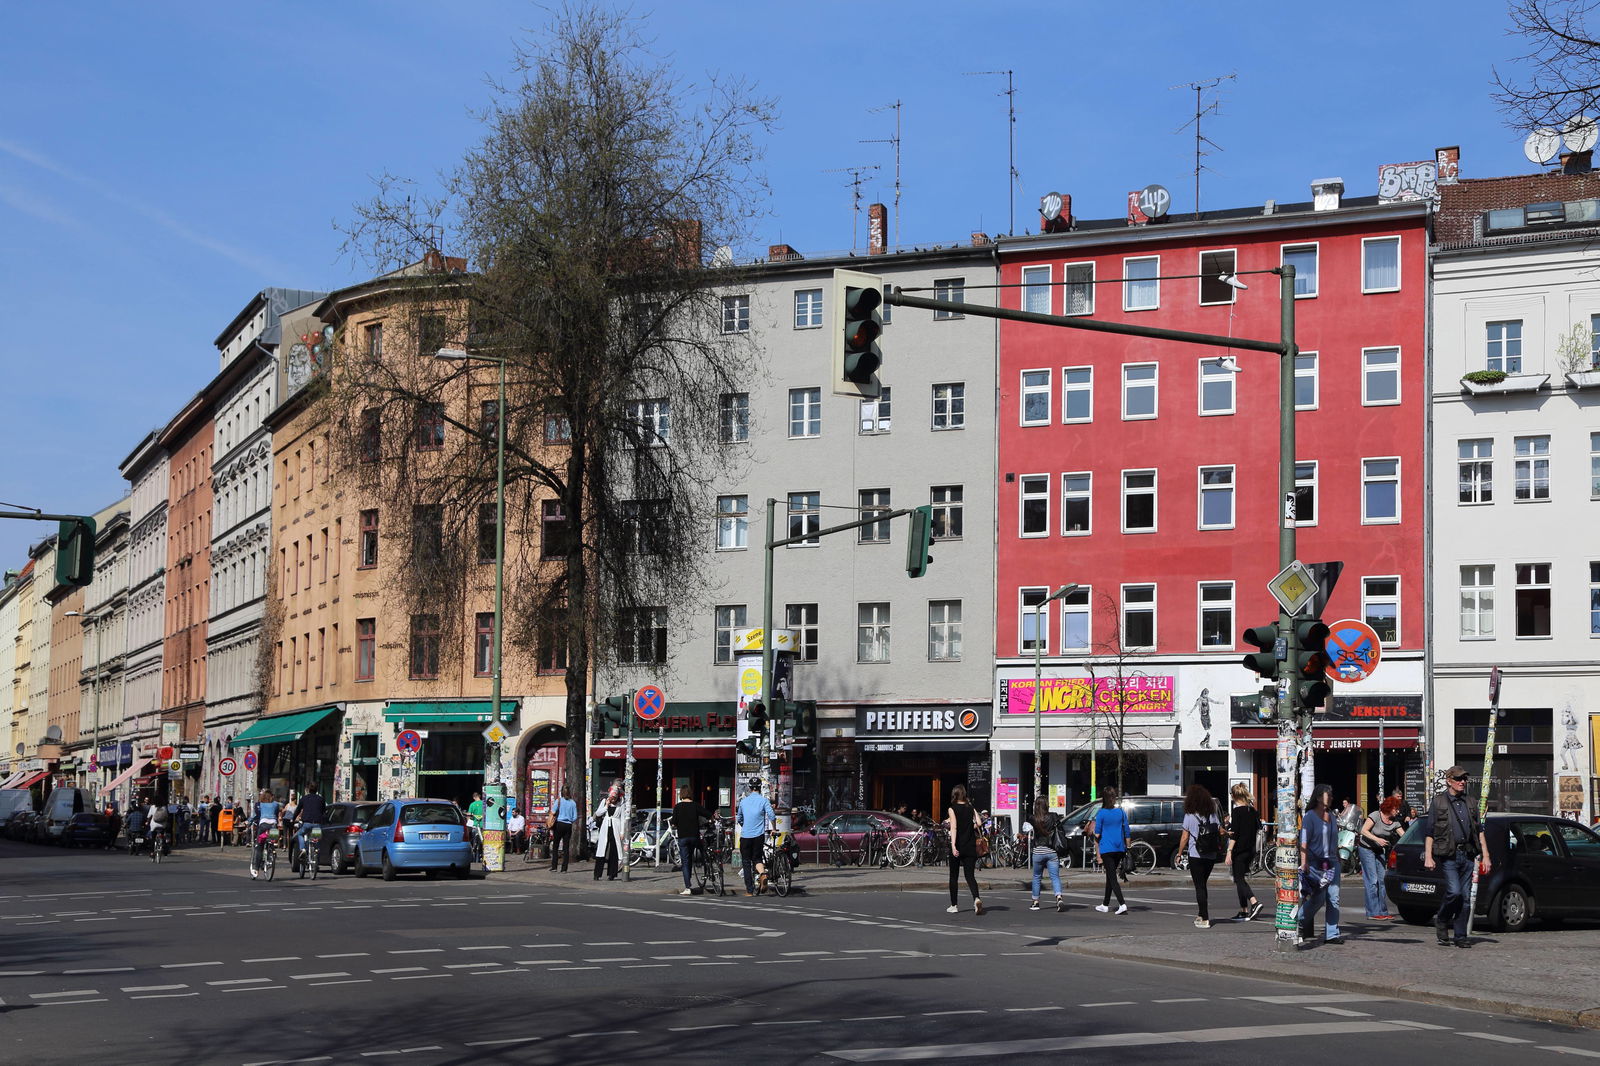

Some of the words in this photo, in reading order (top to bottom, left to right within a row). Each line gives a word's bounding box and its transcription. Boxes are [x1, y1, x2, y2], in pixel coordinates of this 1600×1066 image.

[1140, 188, 1170, 212] 1UP
[1055, 678, 1085, 687] FRIED
[1028, 683, 1098, 713] ANGRY
[1099, 690, 1171, 703] CHICKEN
[635, 715, 702, 731] TAQUERIA
[866, 711, 955, 731] PFEIFFERS
[1330, 740, 1361, 748] JENSEITS
[222, 762, 234, 772] 30
